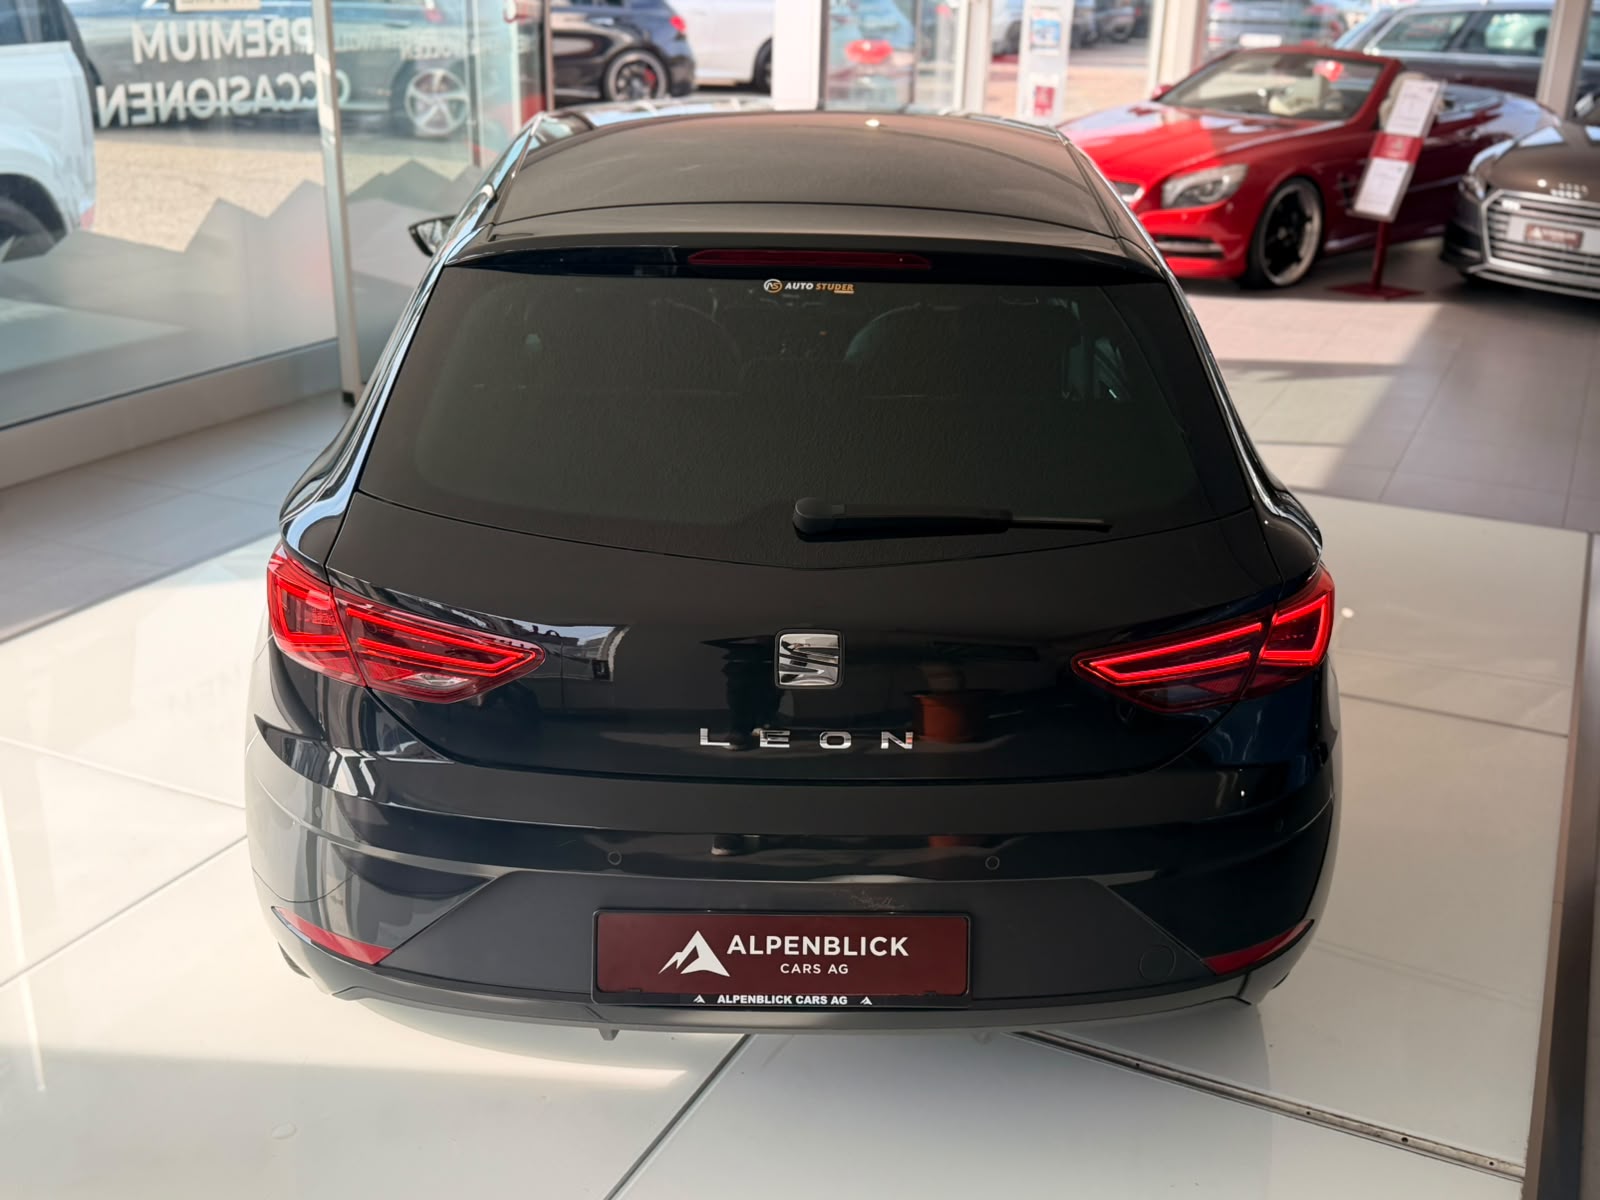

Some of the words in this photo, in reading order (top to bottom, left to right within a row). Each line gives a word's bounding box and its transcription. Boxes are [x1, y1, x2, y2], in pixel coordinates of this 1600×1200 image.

[785, 282, 814, 290] AUTO
[815, 283, 854, 292] STUDER
[700, 728, 913, 749] LEON
[727, 934, 909, 957] ALPENBLICK
[780, 963, 821, 975] CARS
[827, 963, 849, 975] AG
[717, 994, 792, 1005] ALPENBLICK
[795, 995, 829, 1005] CARS
[831, 995, 848, 1005] AG
